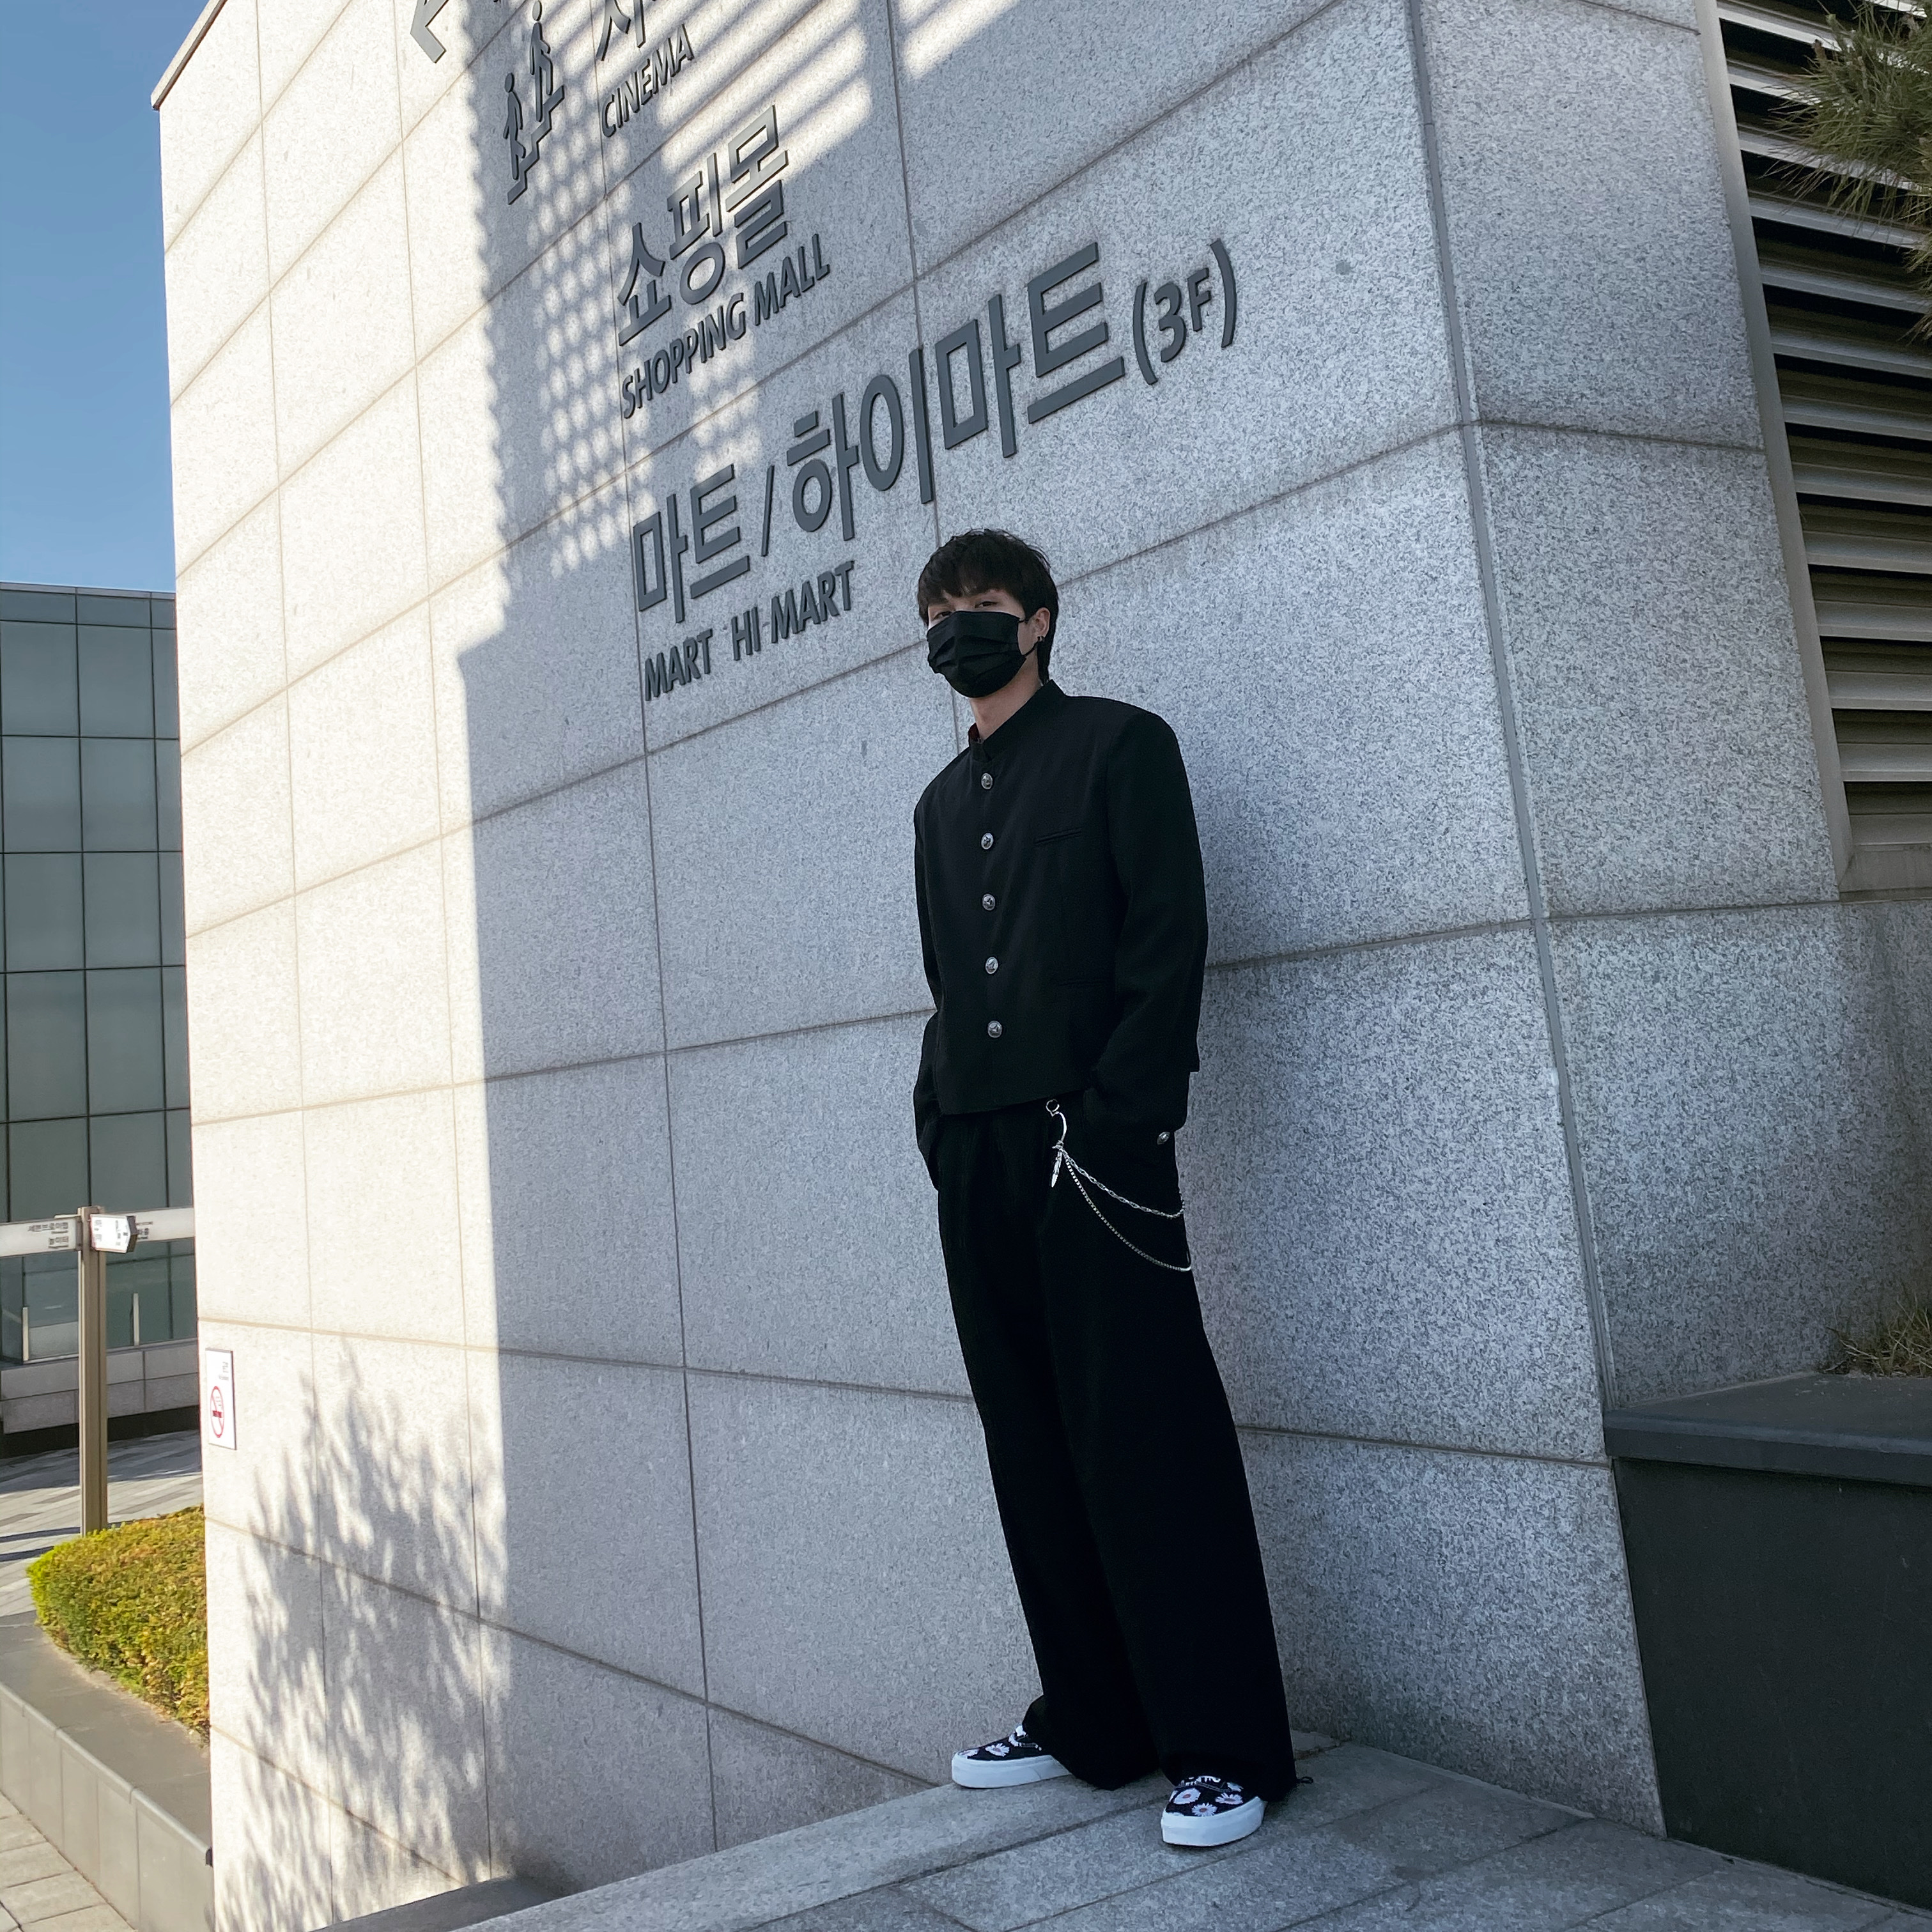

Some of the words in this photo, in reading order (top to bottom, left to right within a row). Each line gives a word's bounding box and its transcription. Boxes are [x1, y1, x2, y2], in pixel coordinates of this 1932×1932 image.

[601, 24, 695, 137] CINEMA
[617, 105, 789, 347] 쇼핑몰
[623, 293, 746, 419] SHOPPING
[754, 233, 831, 327] MALL
[644, 628, 713, 702] MART
[771, 560, 855, 644] MART
